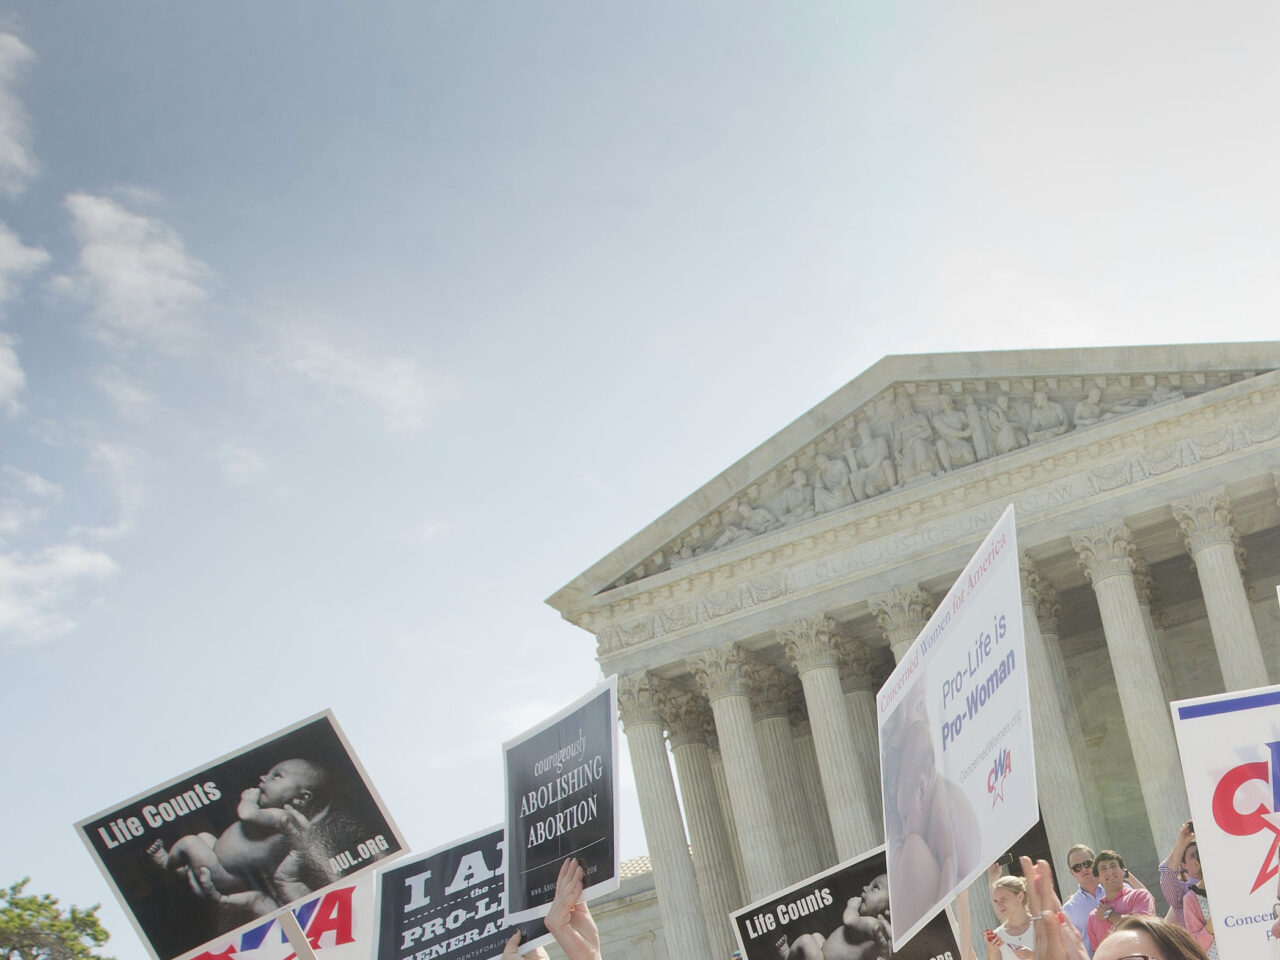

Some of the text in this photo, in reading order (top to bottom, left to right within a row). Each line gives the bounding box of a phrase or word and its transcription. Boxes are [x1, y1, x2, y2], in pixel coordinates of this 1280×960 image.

[880, 533, 1007, 713] Concerned Women for America
[942, 613, 1007, 710] Pro-Life is
[941, 649, 1016, 752] Pro-Woman
[534, 728, 586, 777] courageously
[987, 748, 1012, 794] CWA
[97, 780, 222, 850] Life Counts
[519, 754, 603, 818] ABOLISHING
[527, 794, 598, 848] ABORTION
[328, 834, 390, 874] AUL.ORG
[403, 840, 504, 913] I A
[470, 884, 489, 899] the
[745, 887, 834, 940] Life Counts
